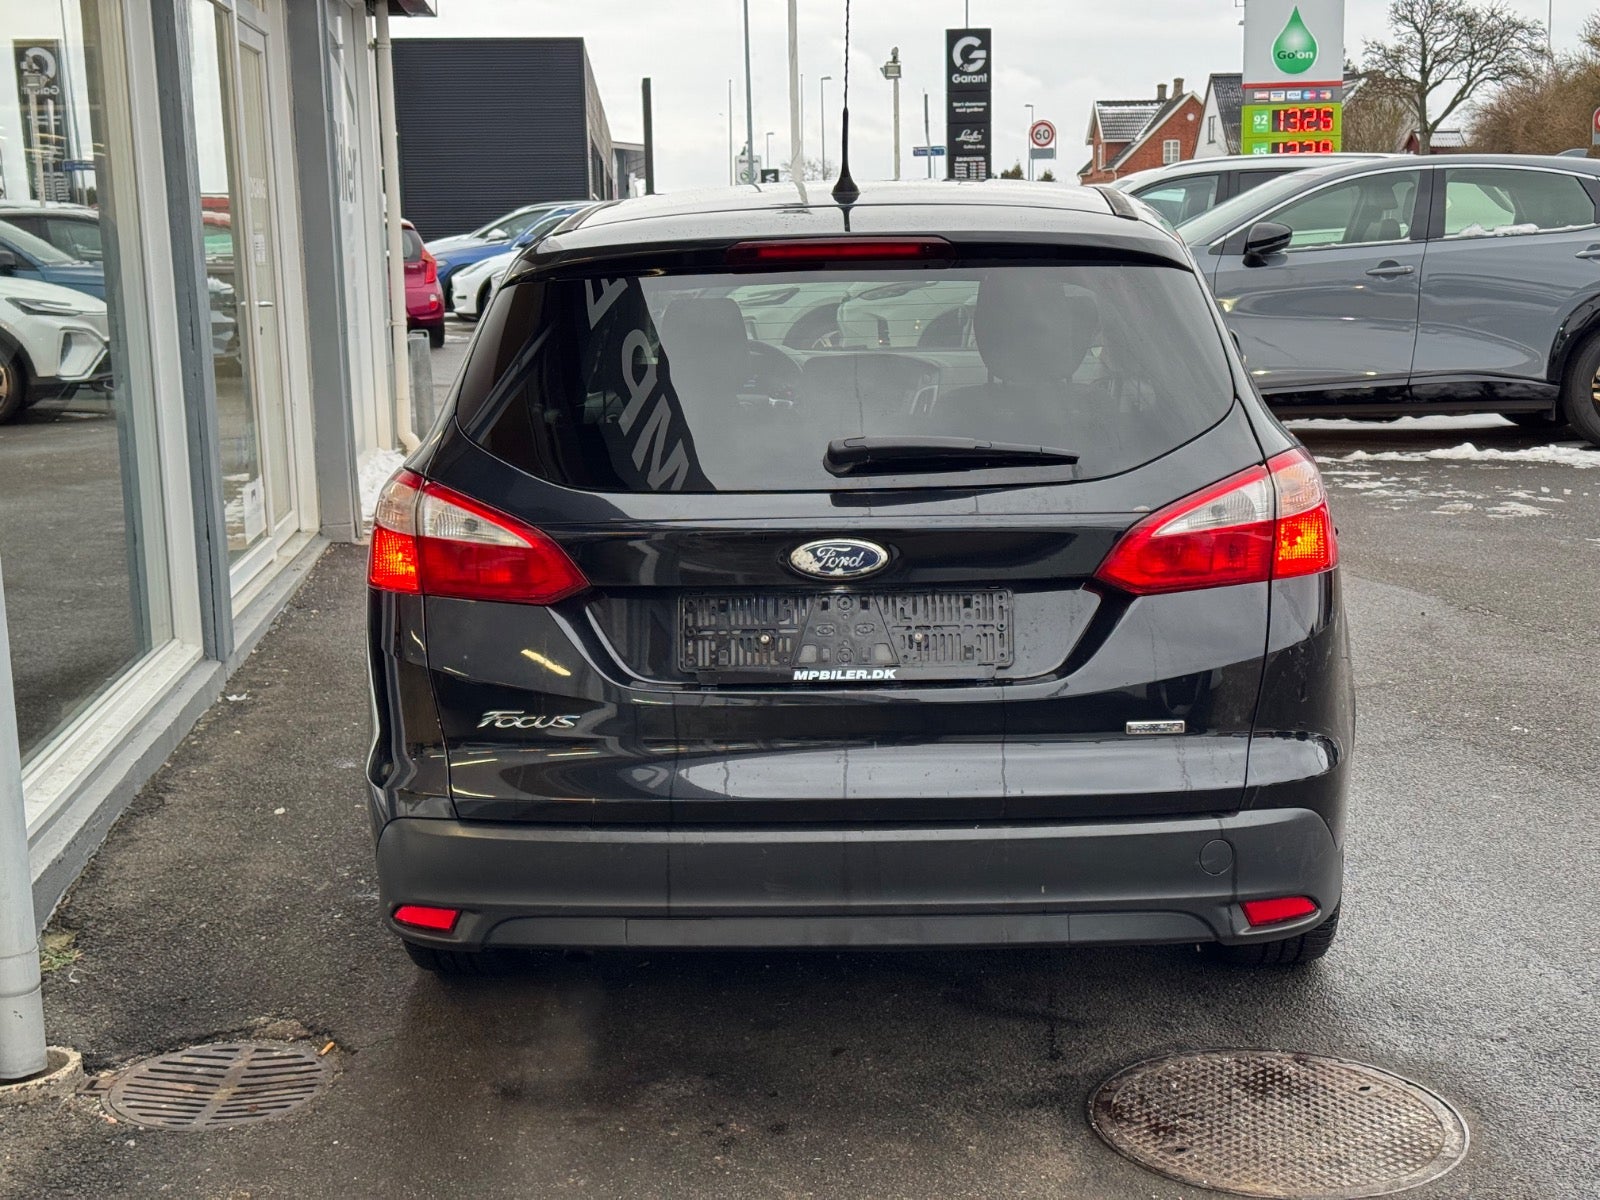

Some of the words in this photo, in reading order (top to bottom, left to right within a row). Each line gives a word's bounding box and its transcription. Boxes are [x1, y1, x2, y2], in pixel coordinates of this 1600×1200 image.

[952, 73, 987, 84] Garant
[1254, 115, 1268, 125] 92
[1035, 130, 1050, 140] 60
[816, 546, 865, 569] Ford
[793, 669, 897, 681] MPBILER.DK
